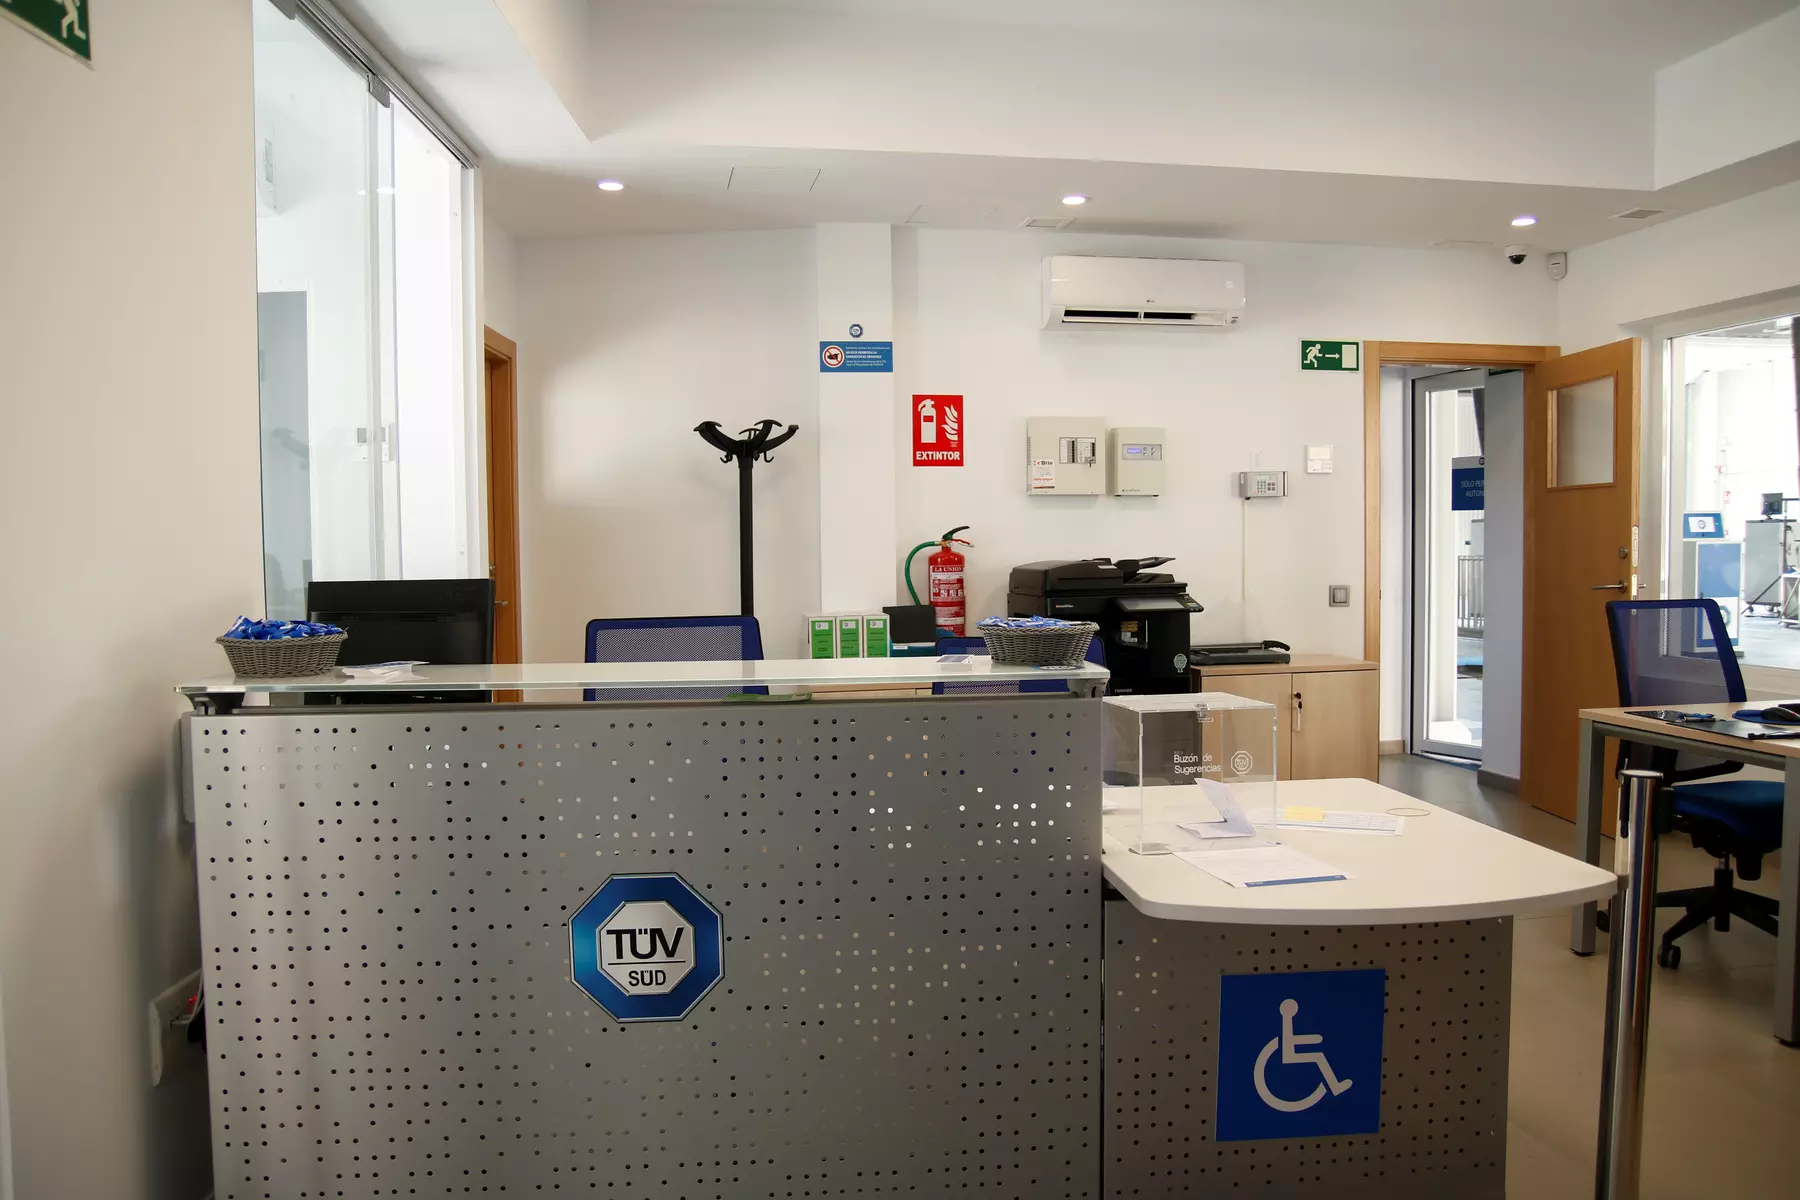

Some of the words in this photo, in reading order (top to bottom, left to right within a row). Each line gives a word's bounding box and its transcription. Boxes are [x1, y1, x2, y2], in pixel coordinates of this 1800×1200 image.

[916, 451, 960, 460] EXTINTOR
[1173, 753, 1198, 763] Buzón
[1203, 753, 1212, 762] de
[1174, 763, 1221, 775] Sugerencias
[606, 927, 684, 960] TÜV
[628, 970, 666, 986] SÜD
